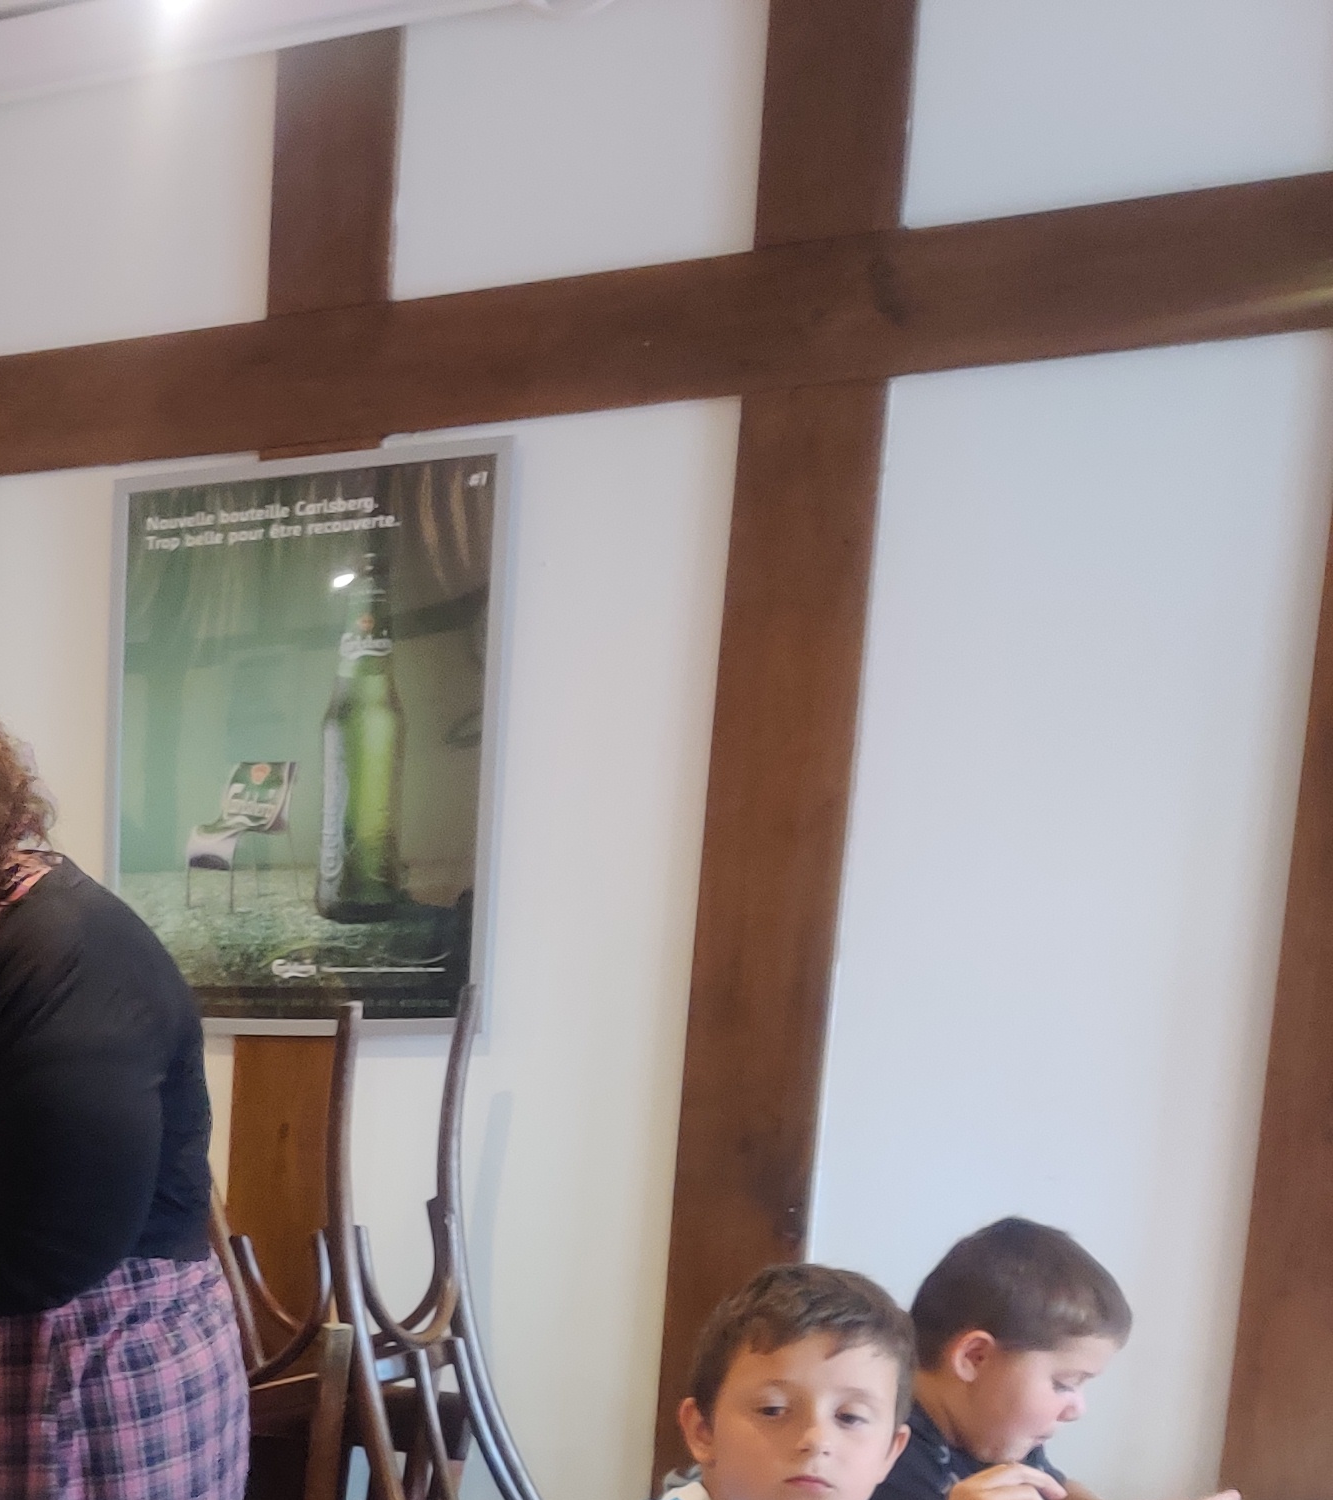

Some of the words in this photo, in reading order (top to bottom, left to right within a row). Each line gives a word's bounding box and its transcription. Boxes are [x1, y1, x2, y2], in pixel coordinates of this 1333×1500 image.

[145, 511, 215, 532] Nouvelle
[220, 504, 290, 524] bouteille
[295, 497, 379, 517] Carlsberg.
[144, 535, 181, 552] Trop
[184, 530, 224, 548] belle
[227, 527, 265, 546] pour
[268, 520, 303, 540] être
